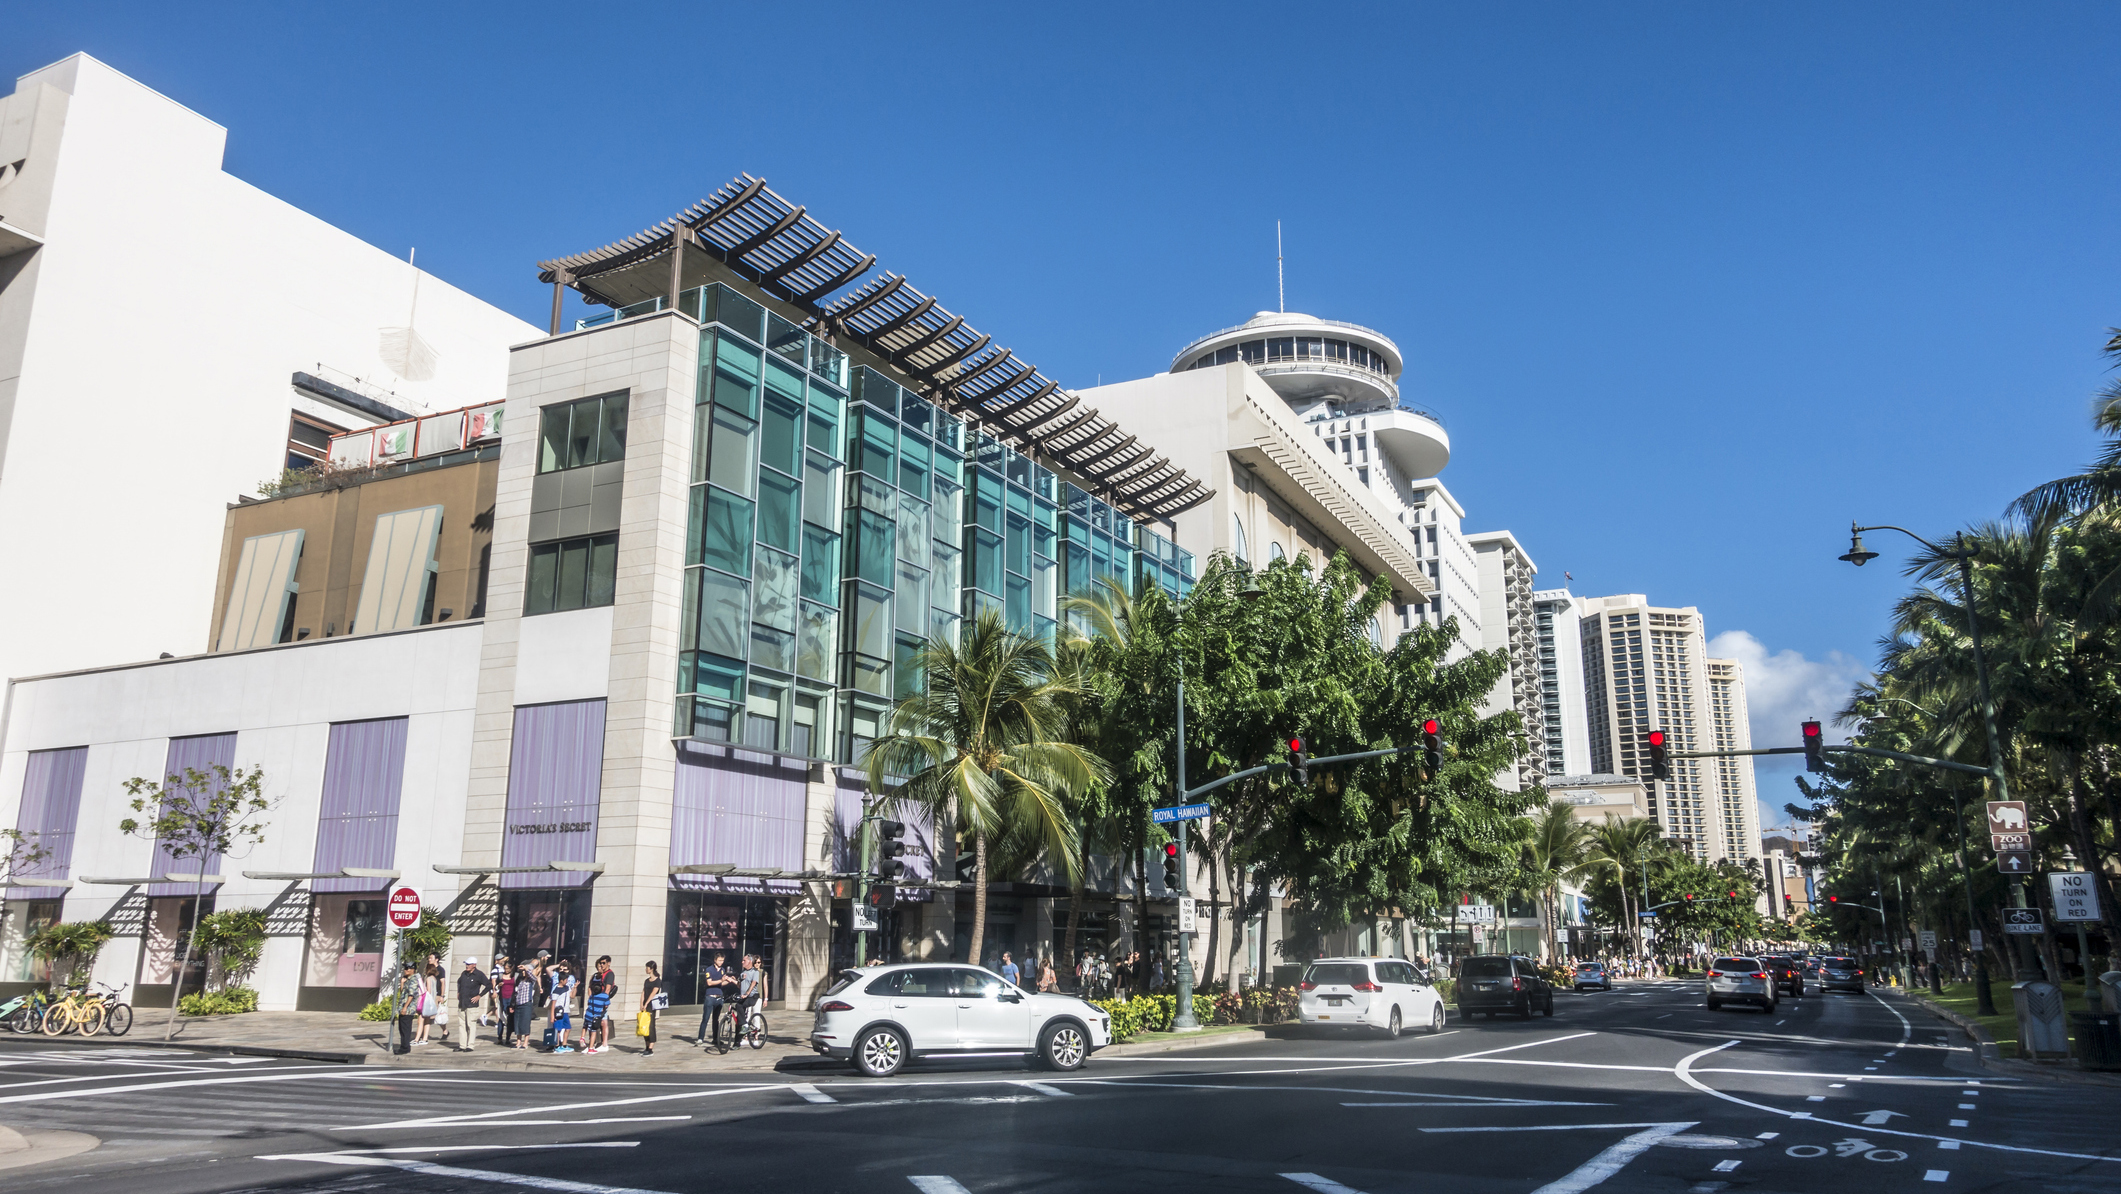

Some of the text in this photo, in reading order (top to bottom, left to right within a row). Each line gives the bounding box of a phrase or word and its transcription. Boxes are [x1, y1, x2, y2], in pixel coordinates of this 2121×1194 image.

[1153, 806, 1209, 821] ROYAL HAWAIIAN
[510, 821, 592, 835] VICTORIA'S SECRET
[2000, 835, 2023, 843] ZOO
[2062, 876, 2082, 886] NO
[2061, 889, 2088, 897] TURN
[2069, 899, 2083, 907] ON
[394, 912, 413, 920] ENTER
[855, 907, 864, 917] NO
[2068, 909, 2087, 917] RED
[1922, 939, 1935, 947] 25
[353, 961, 376, 972] LOVE
